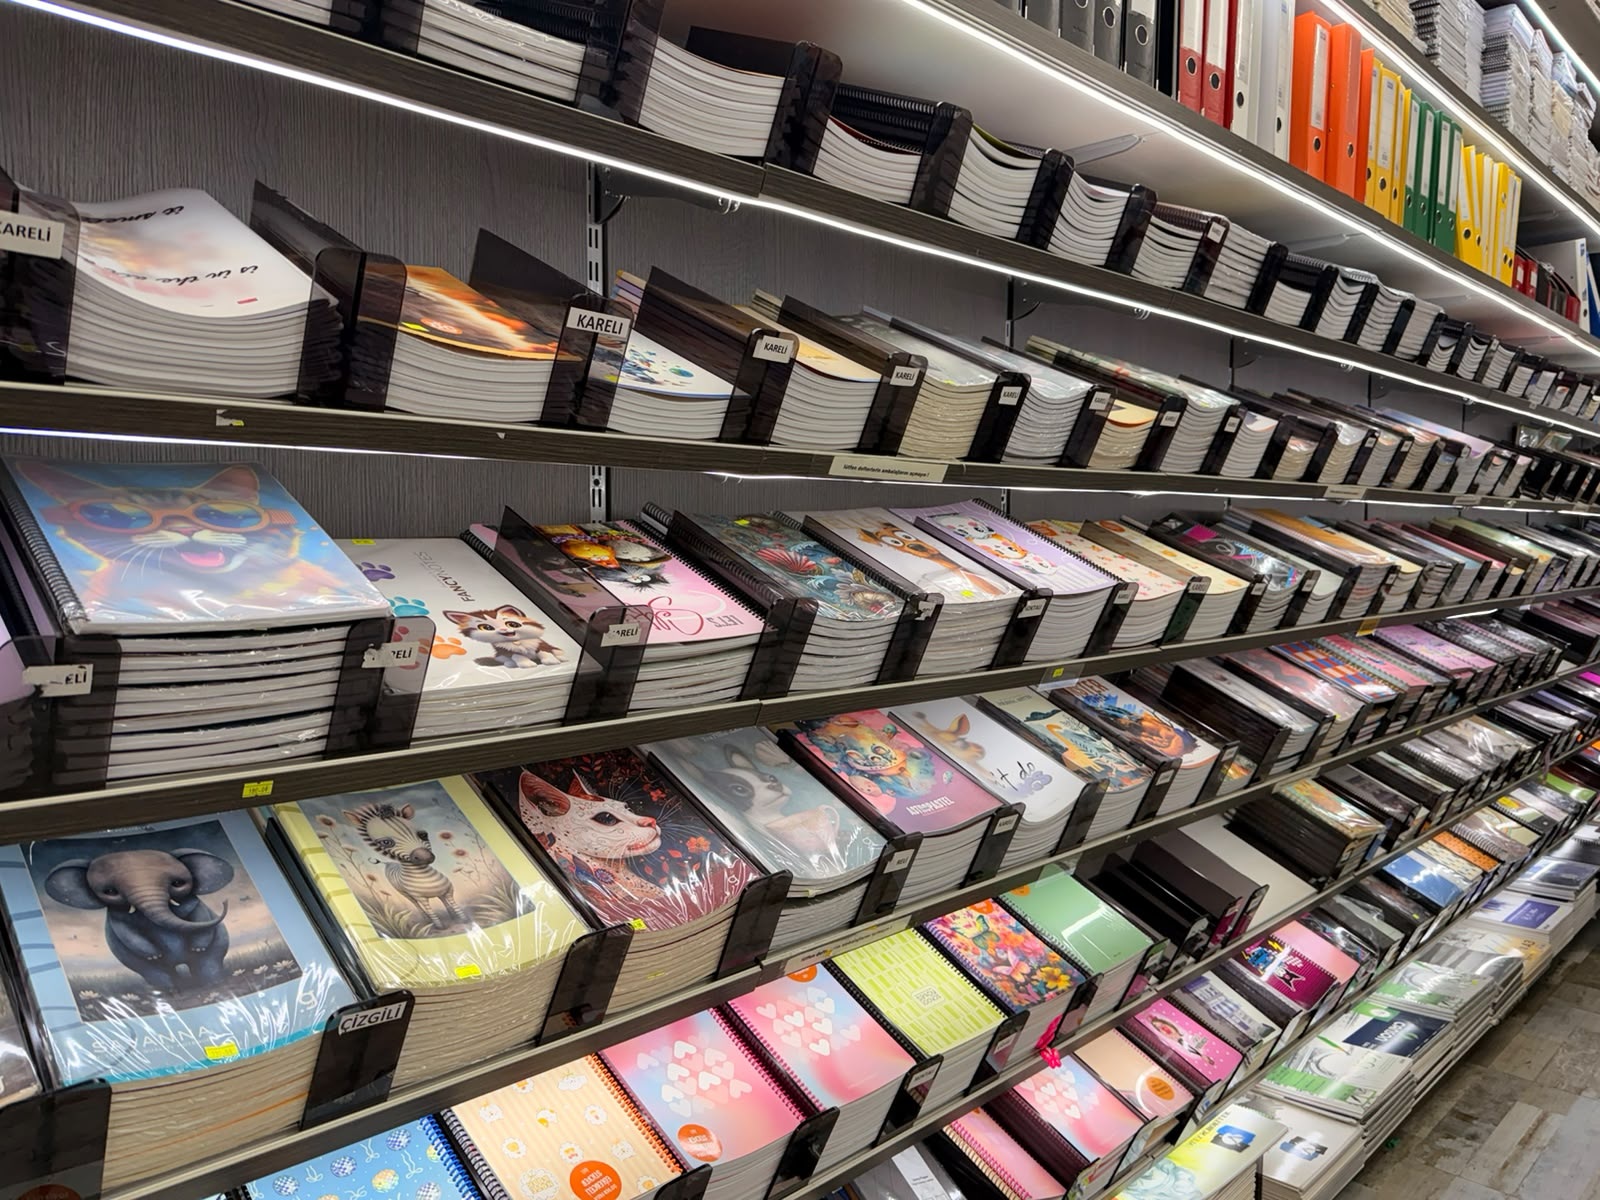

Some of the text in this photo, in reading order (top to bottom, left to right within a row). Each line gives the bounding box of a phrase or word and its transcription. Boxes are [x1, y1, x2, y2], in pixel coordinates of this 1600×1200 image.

[0, 221, 52, 243] ARELİ
[204, 269, 232, 280] in
[239, 264, 260, 275] is
[157, 276, 200, 287] the
[340, 1004, 402, 1032] ÇİZGİLİ
